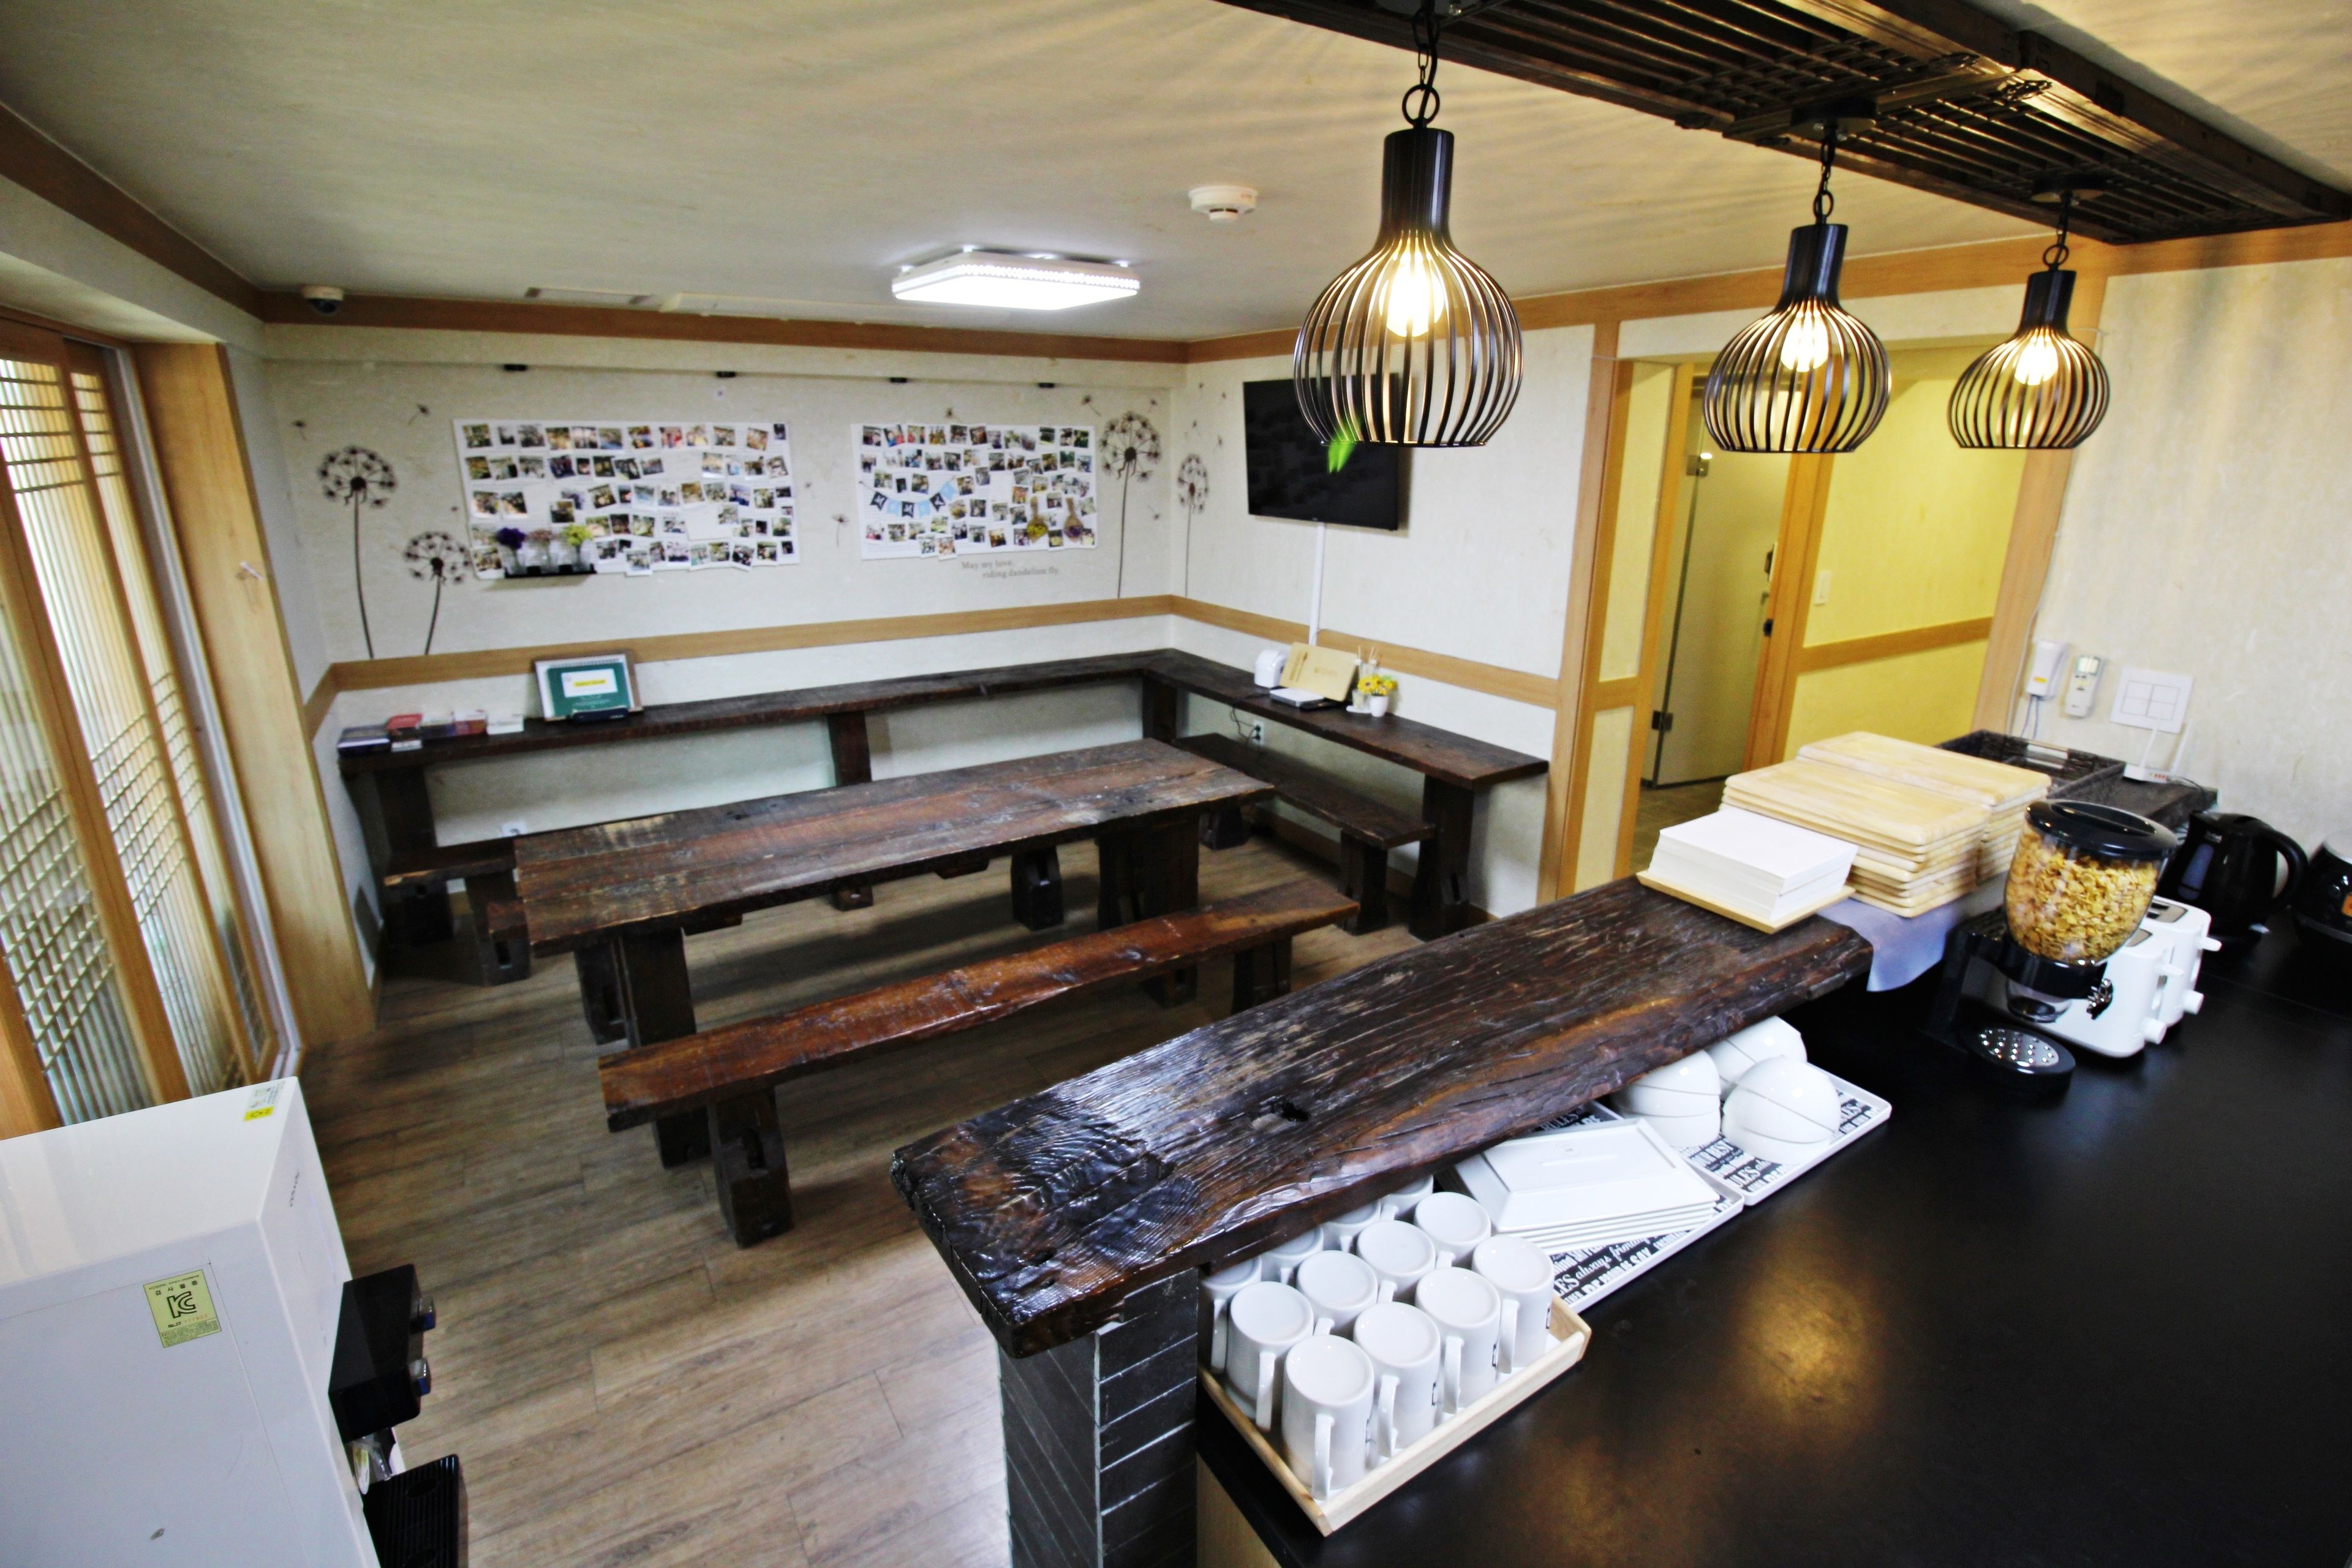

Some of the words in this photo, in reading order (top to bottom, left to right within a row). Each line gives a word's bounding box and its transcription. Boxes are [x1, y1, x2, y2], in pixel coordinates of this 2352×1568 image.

[961, 561, 978, 570] May
[982, 569, 1007, 579] riding
[1008, 567, 1047, 576] dandelion
[1575, 1256, 1612, 1280] always
